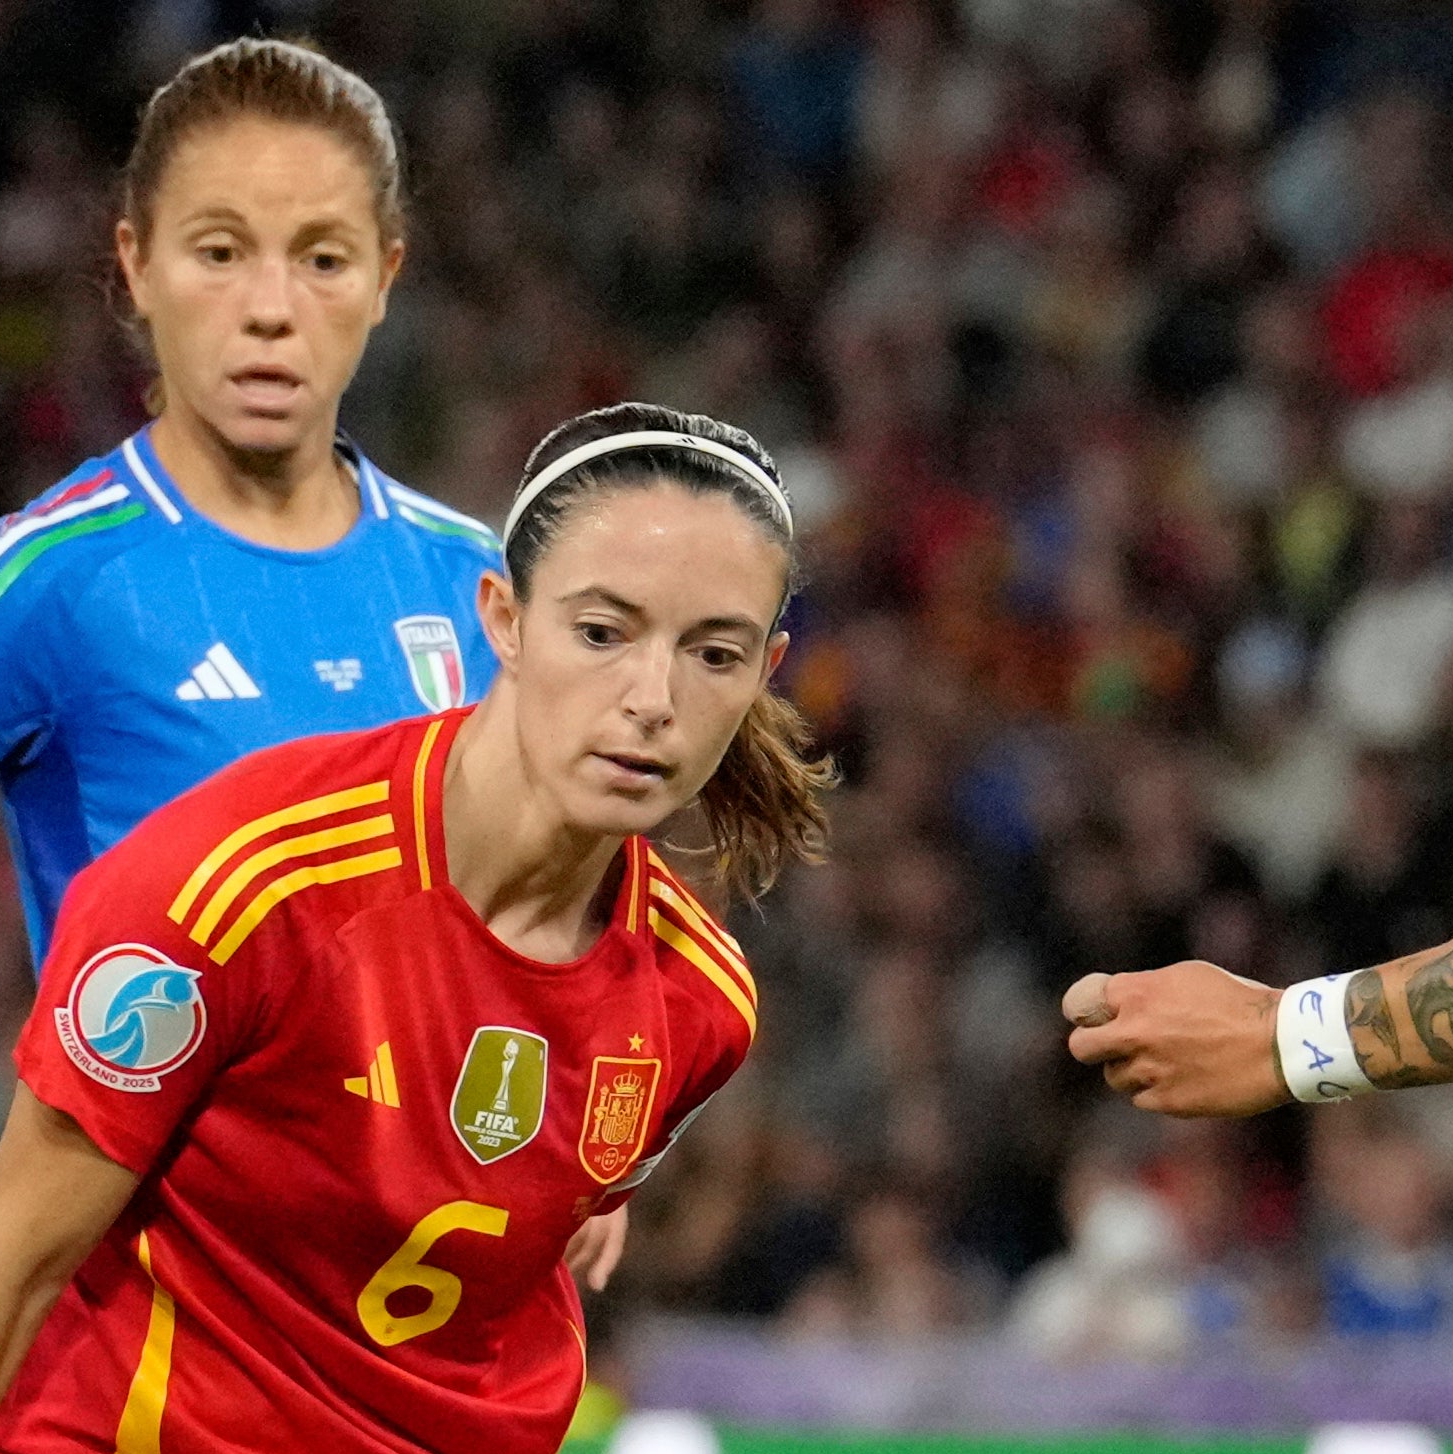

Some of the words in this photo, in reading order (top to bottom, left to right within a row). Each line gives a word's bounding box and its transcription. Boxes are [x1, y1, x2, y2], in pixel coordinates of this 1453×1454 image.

[59, 1012, 119, 1084] SWITZERLAND
[122, 1076, 155, 1088] 2025
[474, 1110, 514, 1133] FIFA
[357, 1200, 509, 1347] 6
